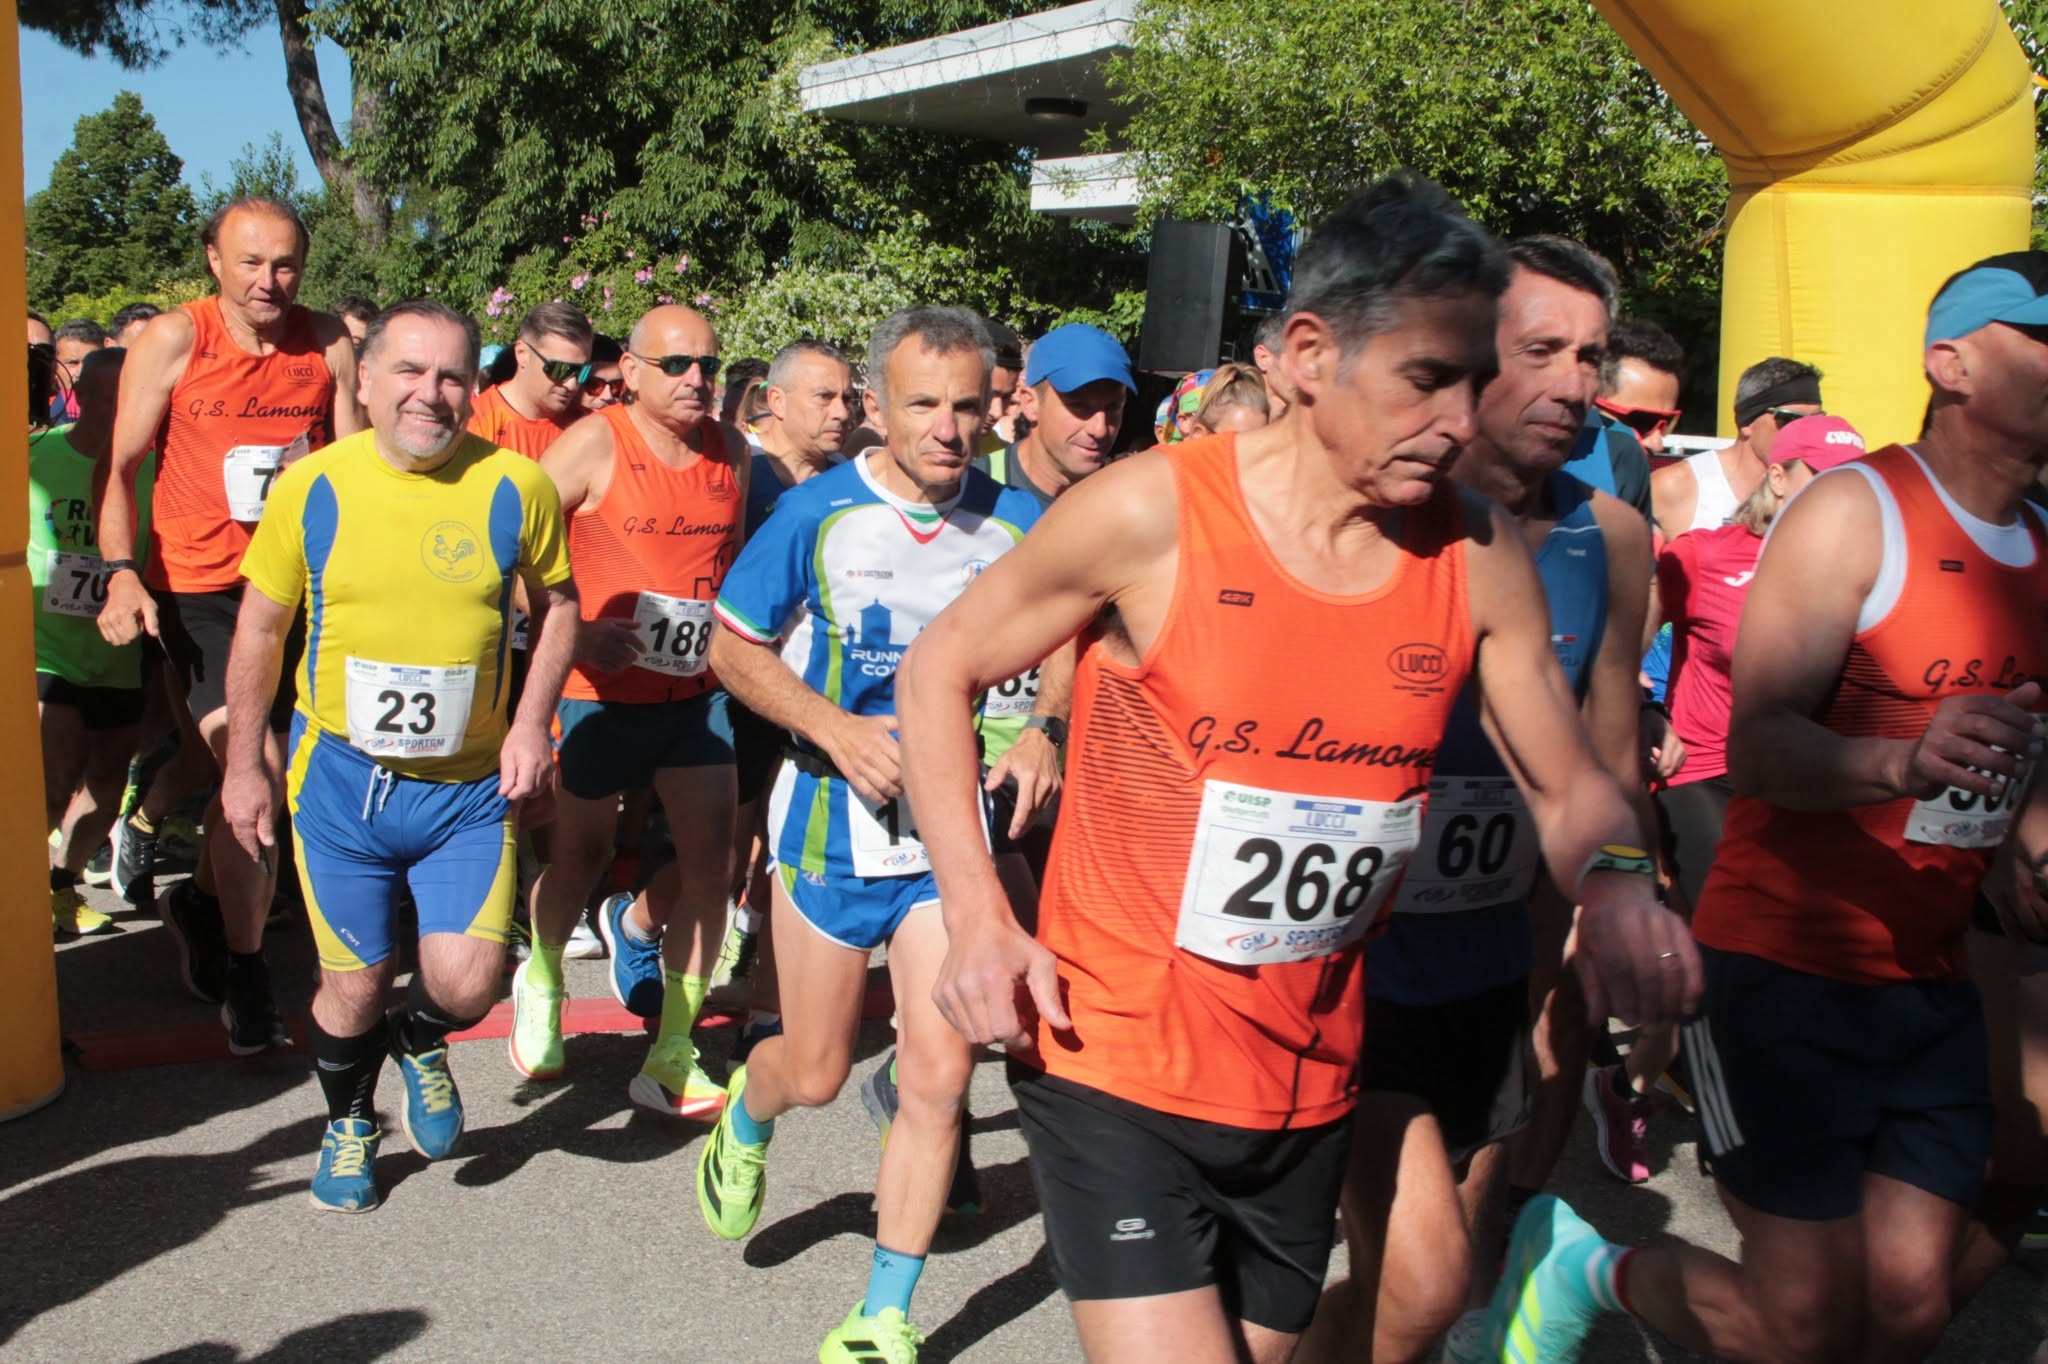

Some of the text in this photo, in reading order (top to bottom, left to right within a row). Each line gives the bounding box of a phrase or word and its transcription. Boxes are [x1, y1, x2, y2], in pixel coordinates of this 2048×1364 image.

[188, 400, 230, 420] G.S.
[623, 516, 659, 536] G.S.
[649, 617, 713, 657] 188
[1399, 653, 1443, 674] LUCCI
[1923, 659, 1984, 693] G.S.
[374, 689, 437, 736] 23
[398, 738, 446, 748] SPORTGM
[1188, 716, 1260, 760] G.S.
[1236, 792, 1272, 808] UISP
[1305, 812, 1346, 830] LUCCI
[1436, 812, 1517, 879] 60
[1222, 837, 1384, 922] 268
[1239, 933, 1267, 952] GM
